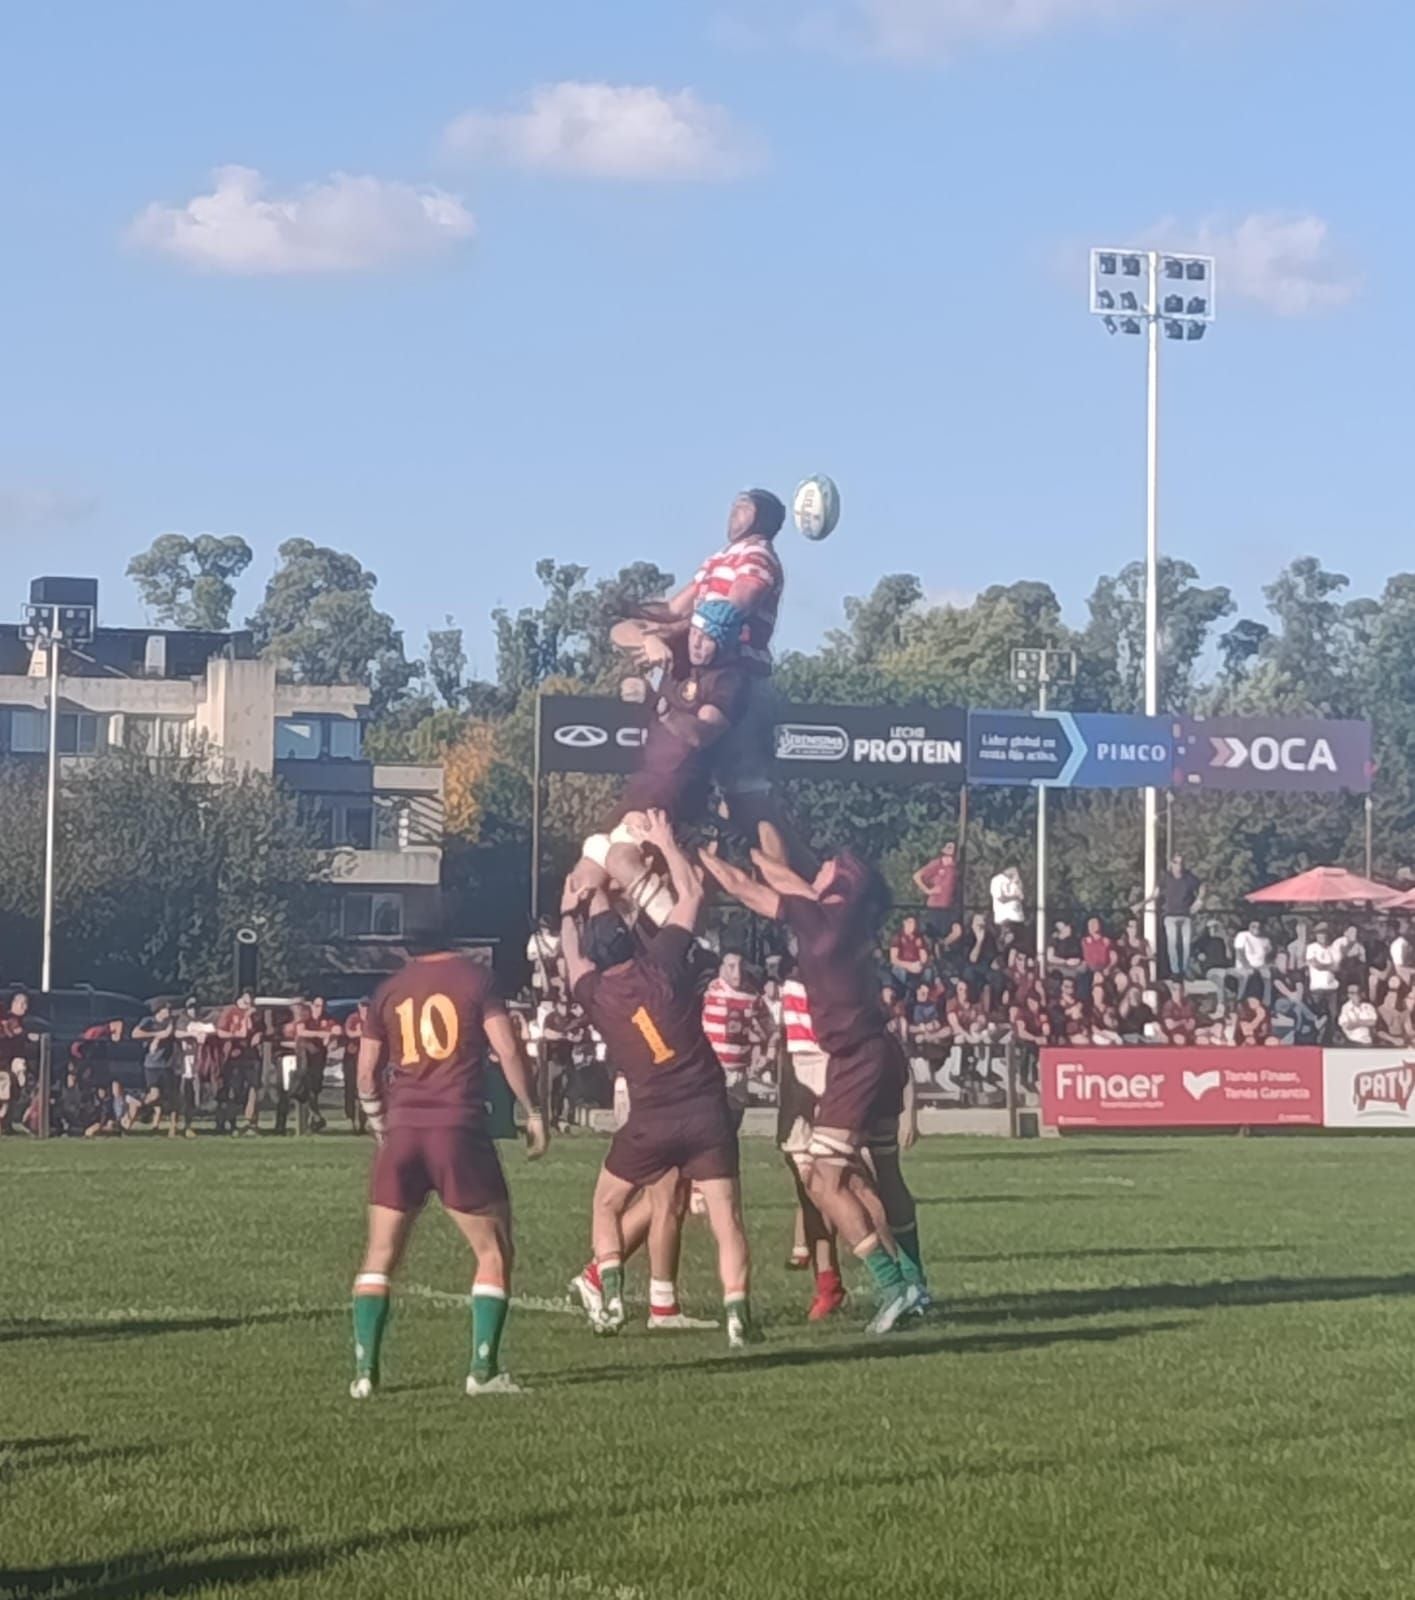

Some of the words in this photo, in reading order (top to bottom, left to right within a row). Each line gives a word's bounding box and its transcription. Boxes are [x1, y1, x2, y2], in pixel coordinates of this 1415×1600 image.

[854, 739, 962, 763] PROTEIN
[1097, 743, 1166, 762] PIMCO
[1251, 736, 1337, 772] OCA
[395, 993, 458, 1065] 10
[632, 1005, 675, 1064] 1
[1056, 1063, 1165, 1099] Finaer
[1359, 1069, 1412, 1099] PATY
